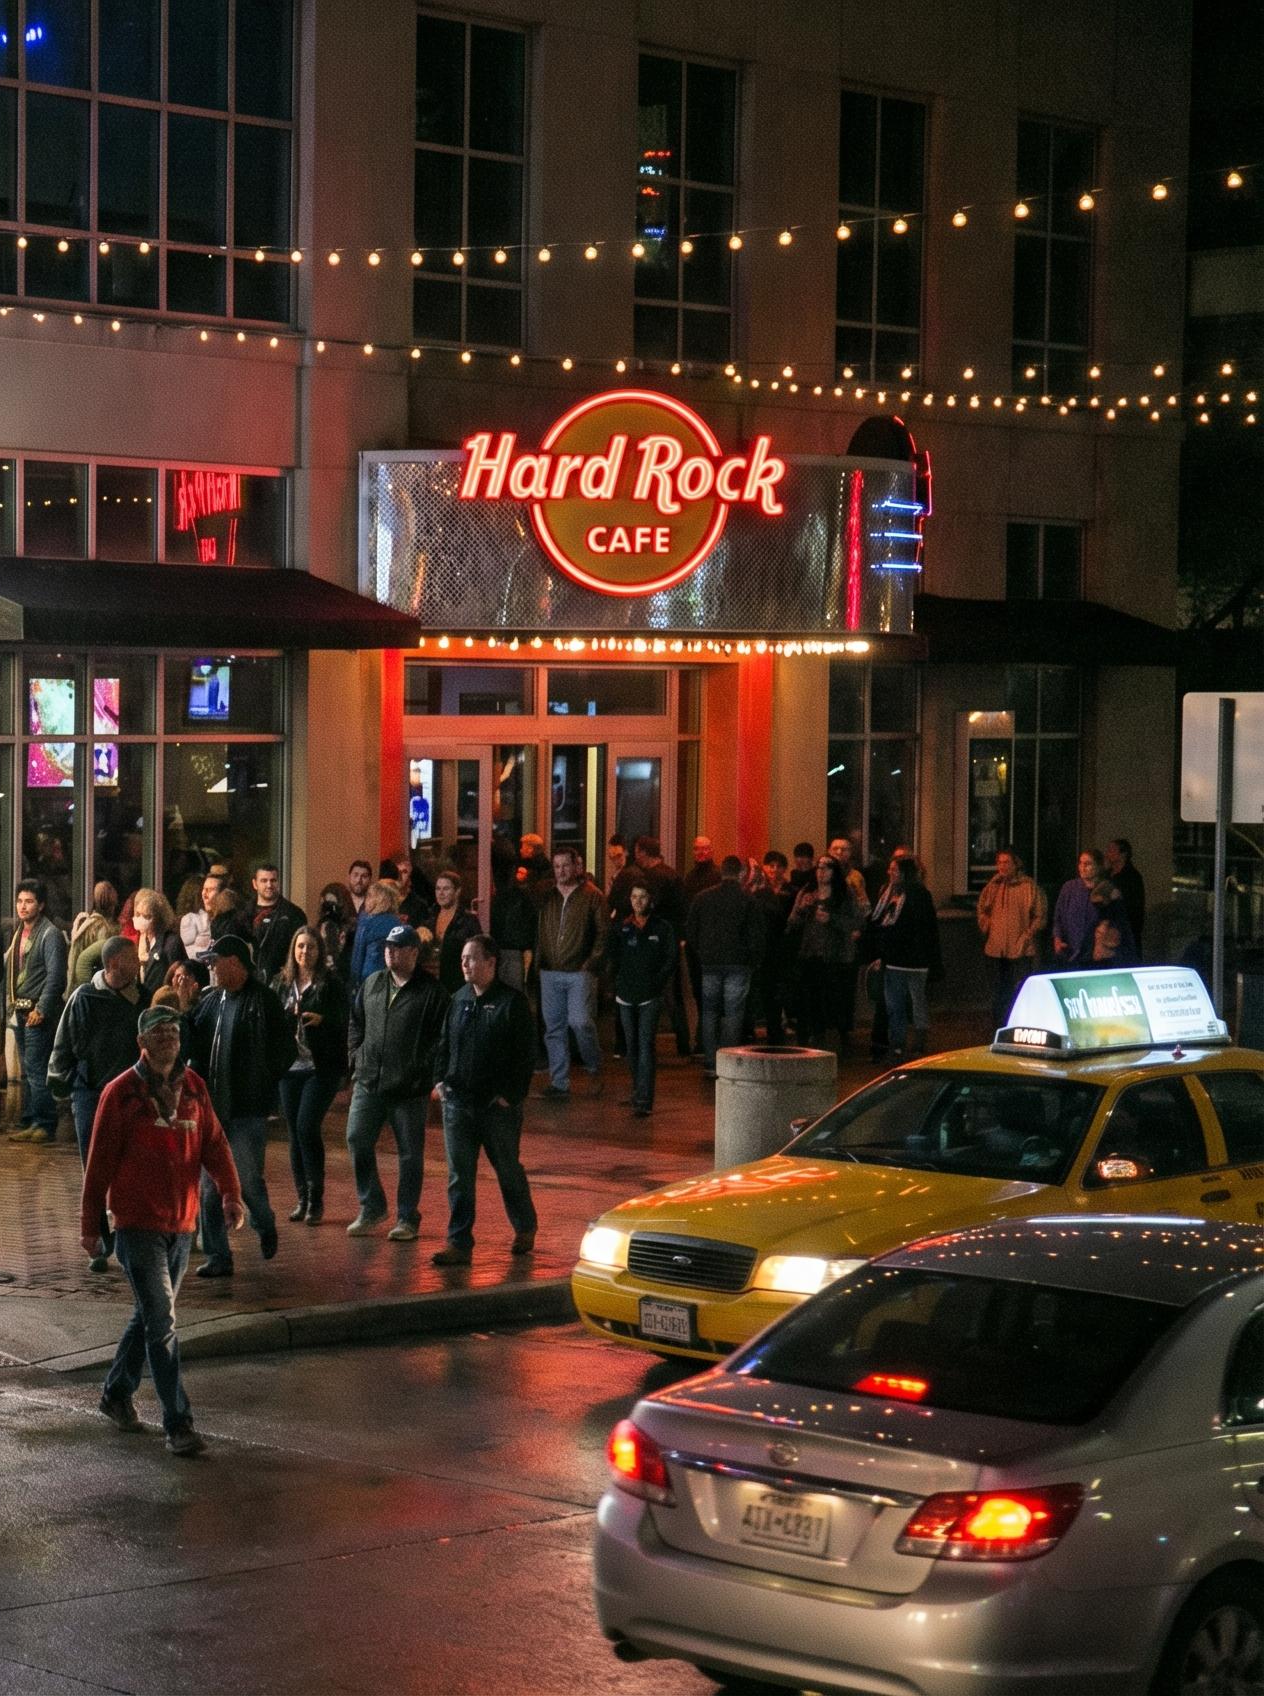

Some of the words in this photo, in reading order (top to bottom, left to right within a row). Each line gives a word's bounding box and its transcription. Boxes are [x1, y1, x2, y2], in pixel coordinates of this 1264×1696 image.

[459, 432, 628, 499] Hard
[633, 434, 786, 516] Rock
[587, 526, 671, 554] CAFE
